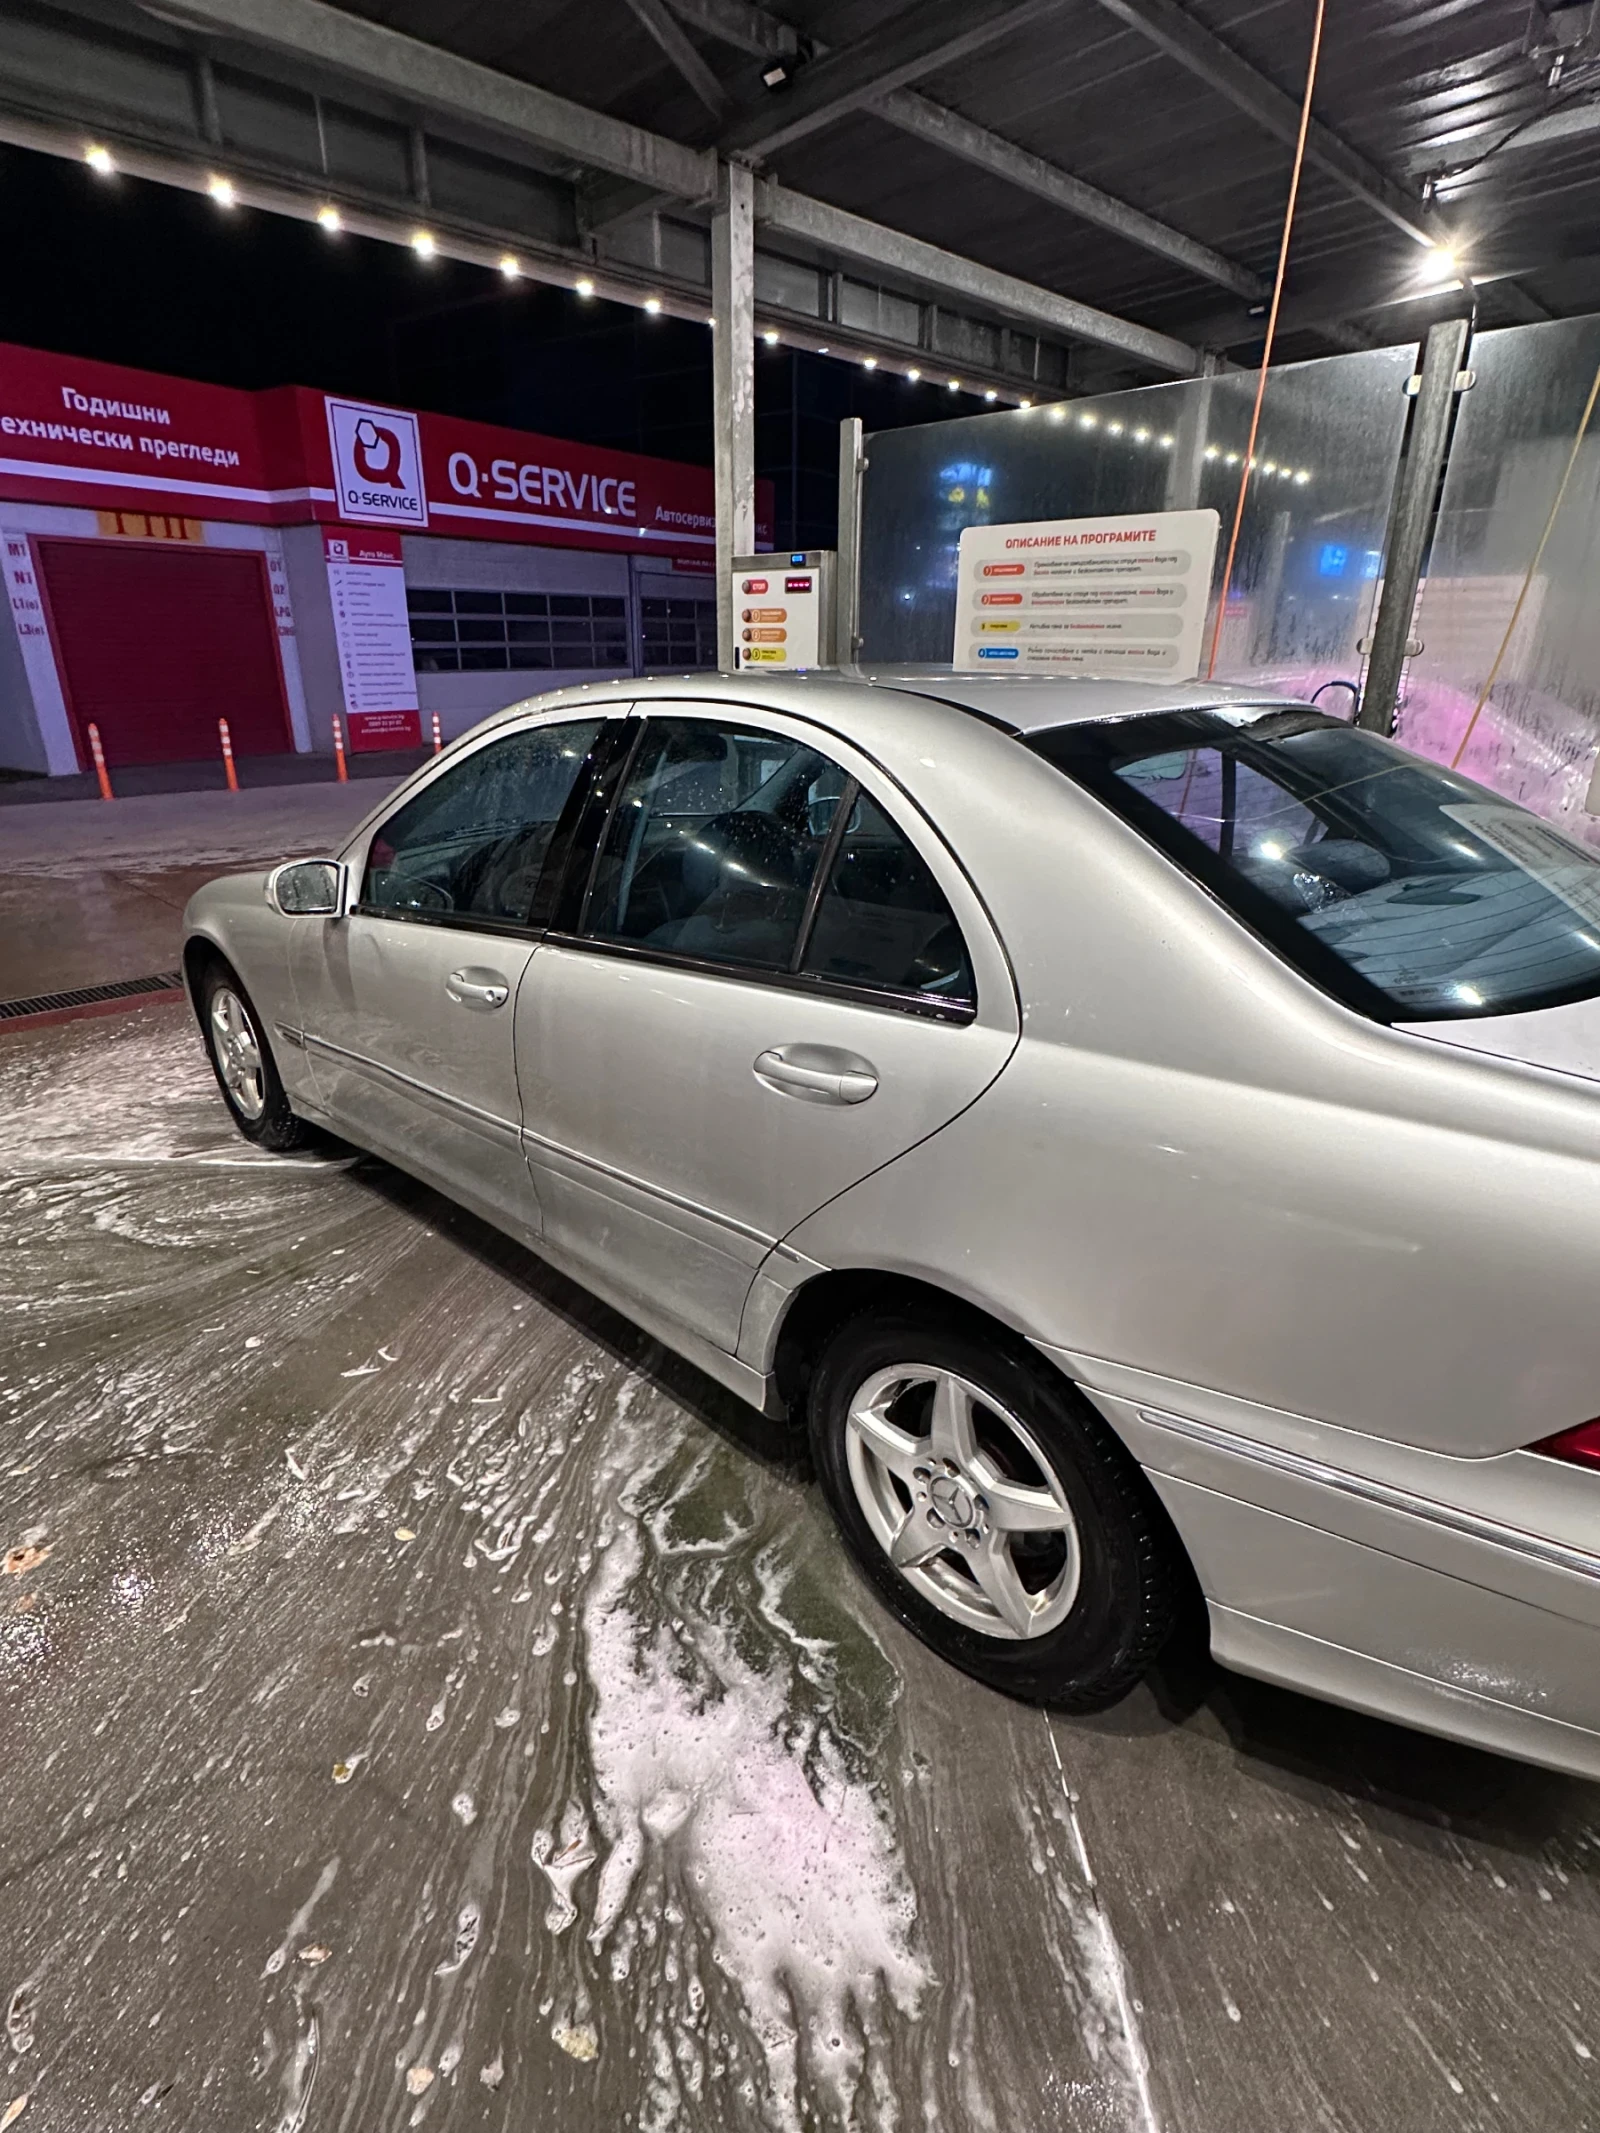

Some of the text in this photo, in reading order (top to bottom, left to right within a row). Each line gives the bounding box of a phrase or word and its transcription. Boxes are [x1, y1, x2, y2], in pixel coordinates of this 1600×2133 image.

[61, 386, 171, 425] Годишни
[0, 416, 240, 468] ехнически прегледи
[1005, 529, 1157, 549] ОПИСАНИЕ НА ПРОГРАМИТЕ
[7, 543, 27, 557] M1
[13, 571, 33, 585] N1
